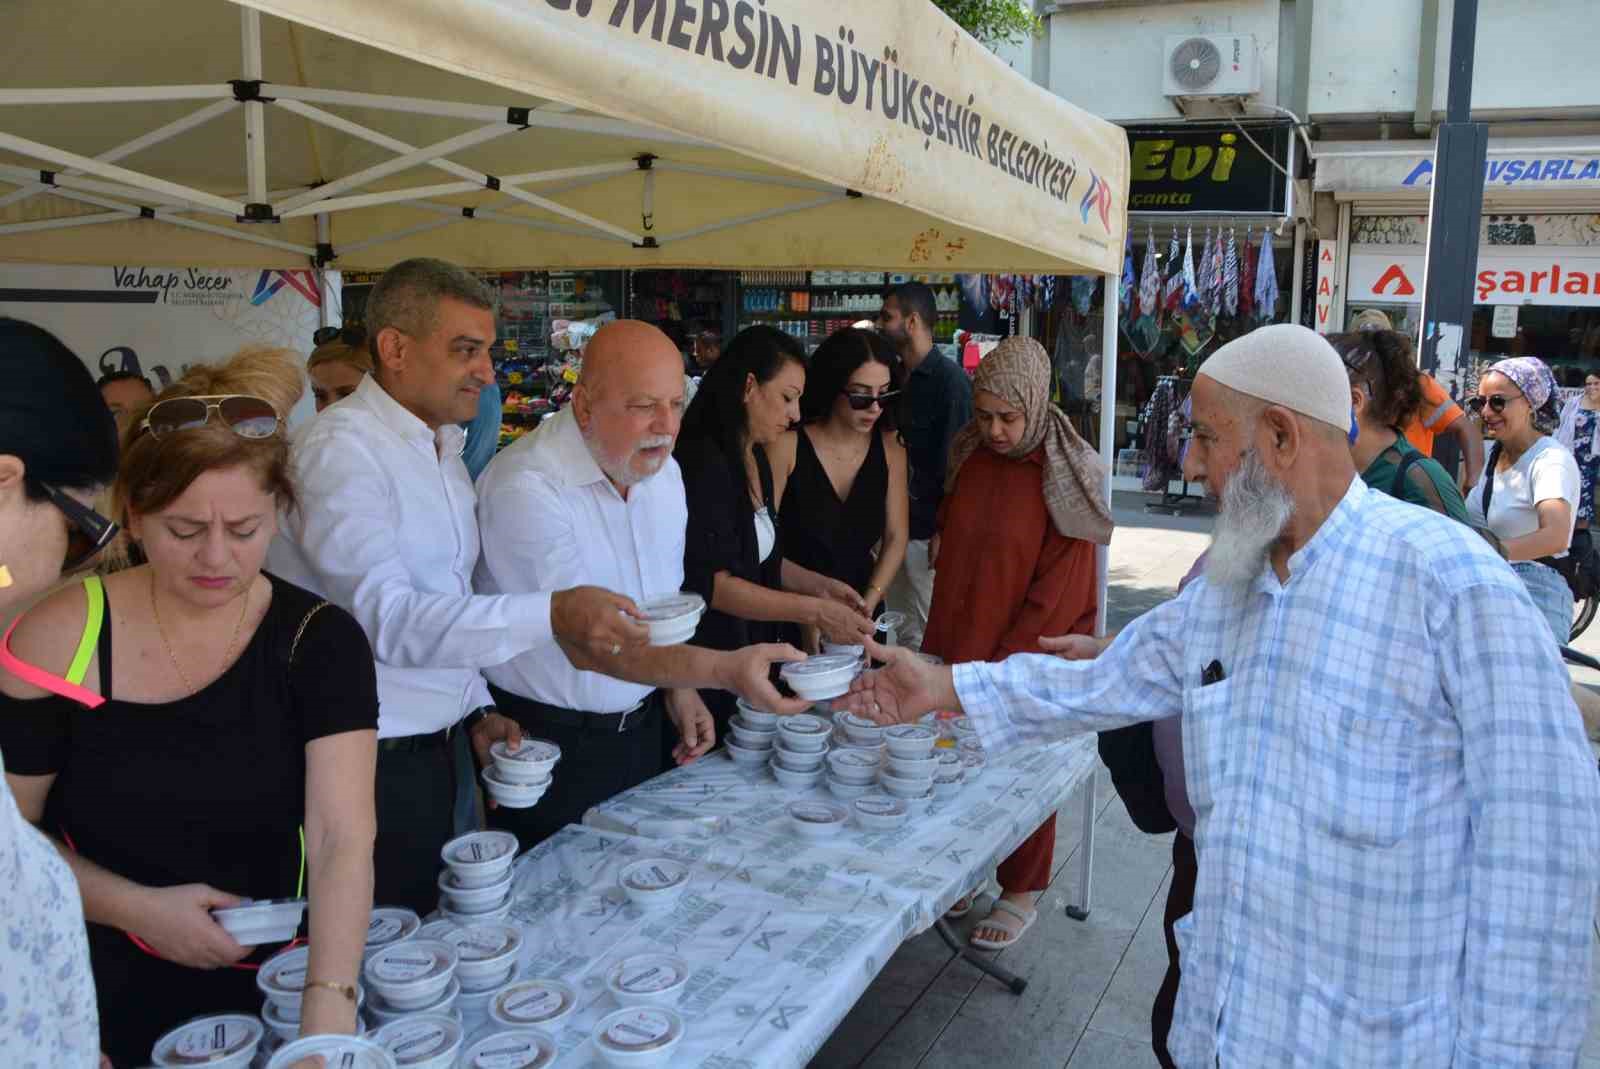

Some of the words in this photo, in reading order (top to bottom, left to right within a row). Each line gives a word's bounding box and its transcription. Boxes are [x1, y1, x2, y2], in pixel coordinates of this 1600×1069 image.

[812, 23, 983, 160] BÜYÜKŞEHİR
[986, 122, 1078, 203] BELEDİYESİ
[1131, 133, 1238, 182] Evi
[113, 265, 180, 304] Vahap
